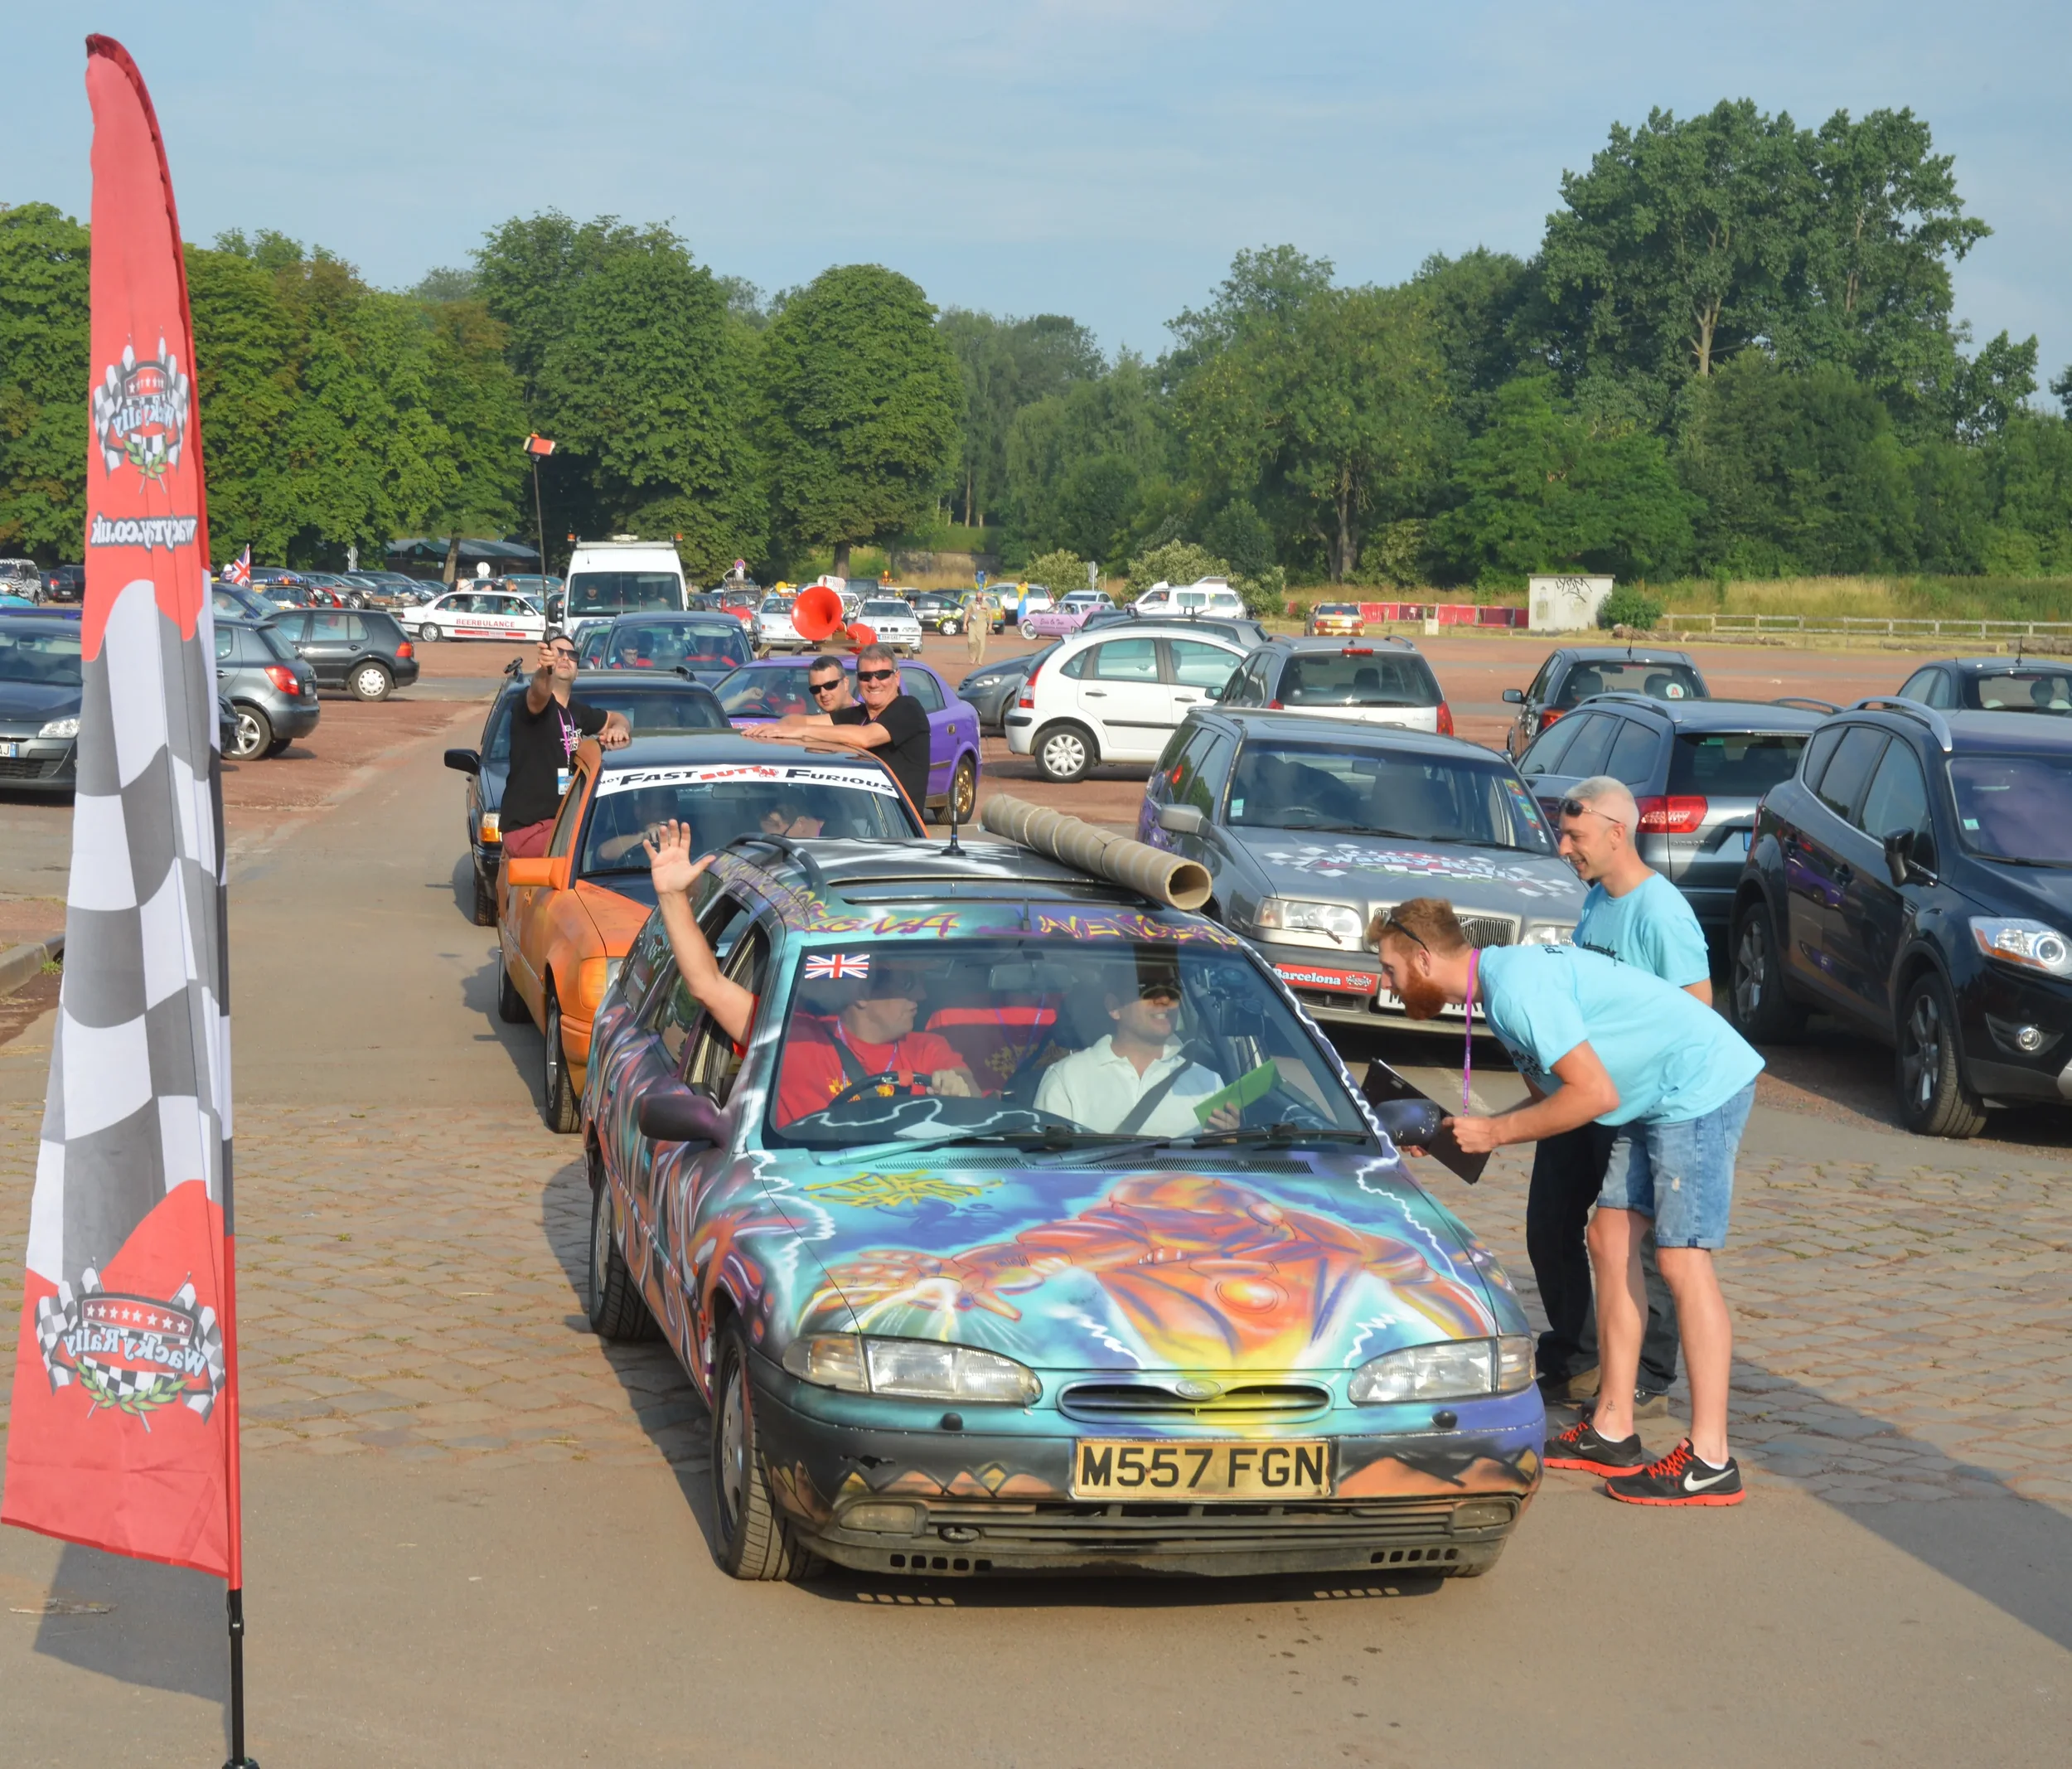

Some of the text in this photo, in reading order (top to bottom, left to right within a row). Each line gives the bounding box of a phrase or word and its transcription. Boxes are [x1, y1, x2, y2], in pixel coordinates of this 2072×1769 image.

[456, 618, 516, 628] BEERBULANCE
[619, 770, 698, 786] FAST
[785, 768, 893, 792] FURIOUS
[1272, 968, 1341, 986] Barcelona
[1081, 1446, 1324, 1488] M557 FGN
